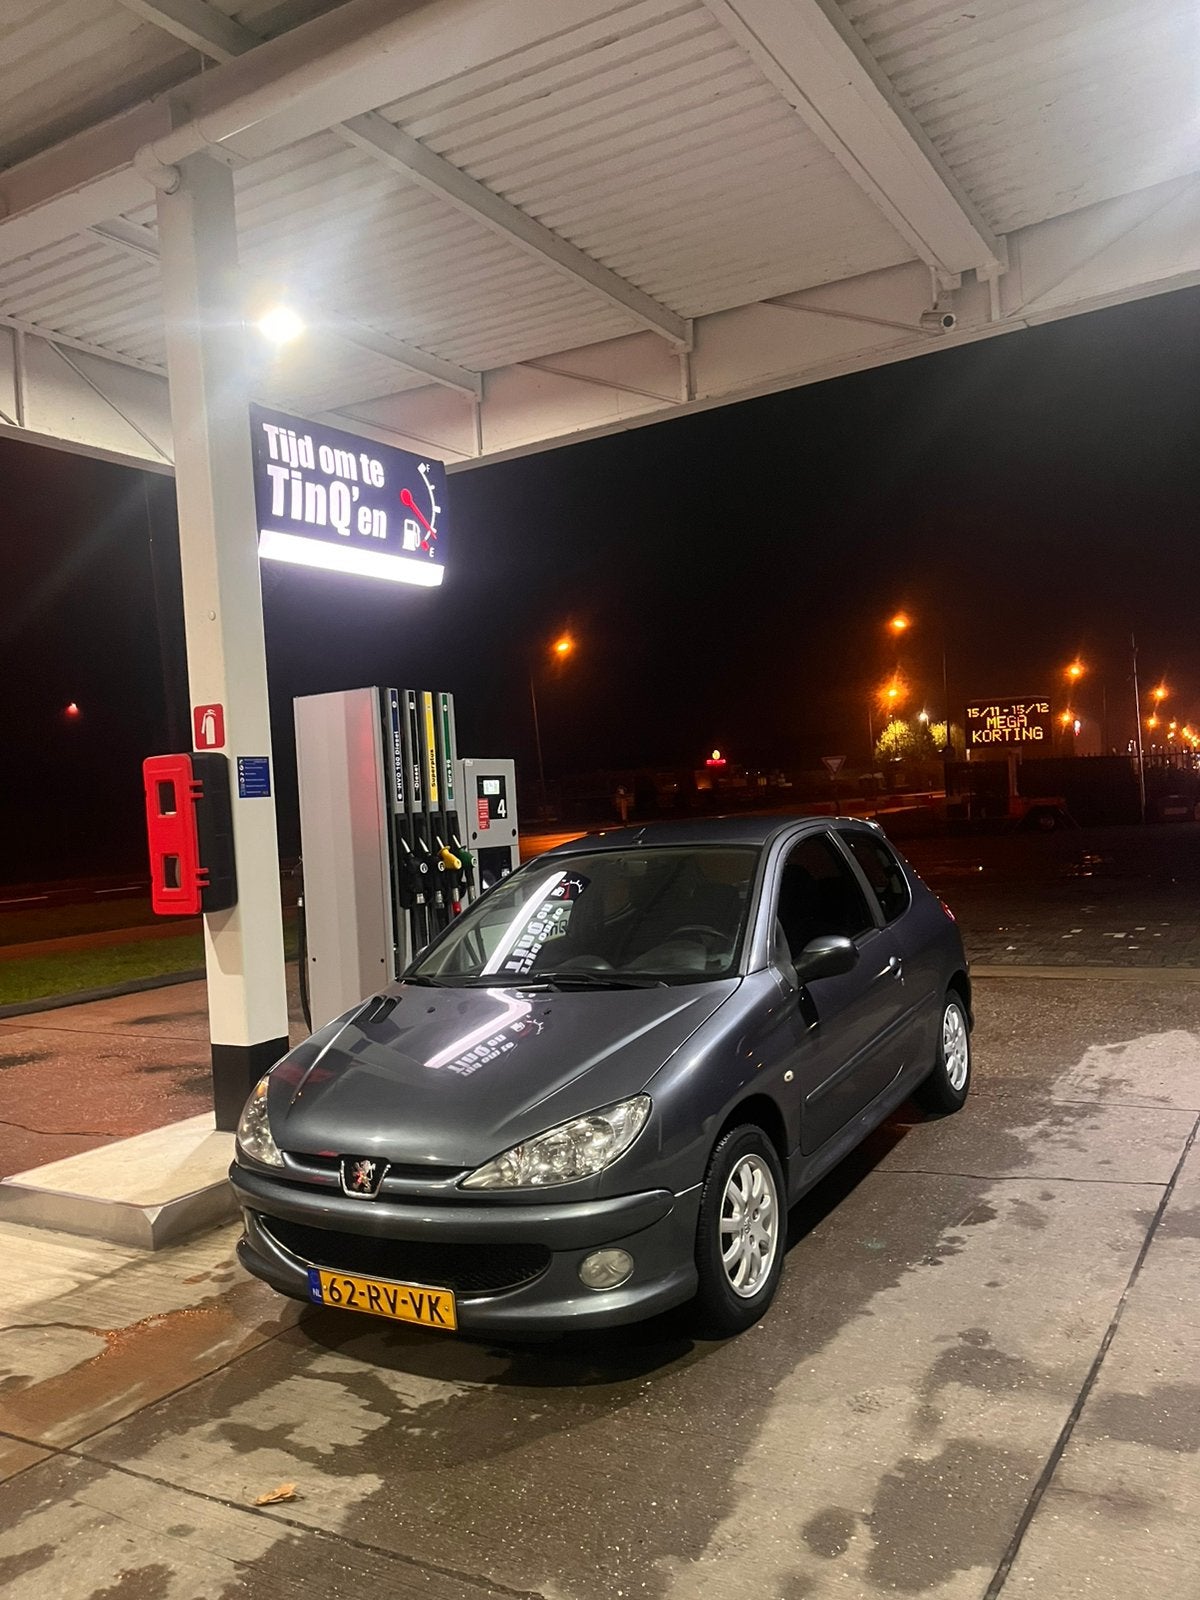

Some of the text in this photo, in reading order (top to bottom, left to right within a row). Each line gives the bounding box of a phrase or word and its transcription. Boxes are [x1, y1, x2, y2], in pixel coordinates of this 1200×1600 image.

[263, 423, 385, 488] Tijd om te
[986, 715, 1027, 729] MEGA
[972, 727, 1043, 743] KORTING
[497, 798, 507, 818] 4
[312, 1287, 323, 1298] NL
[329, 1278, 445, 1323] 62-RV-VK
